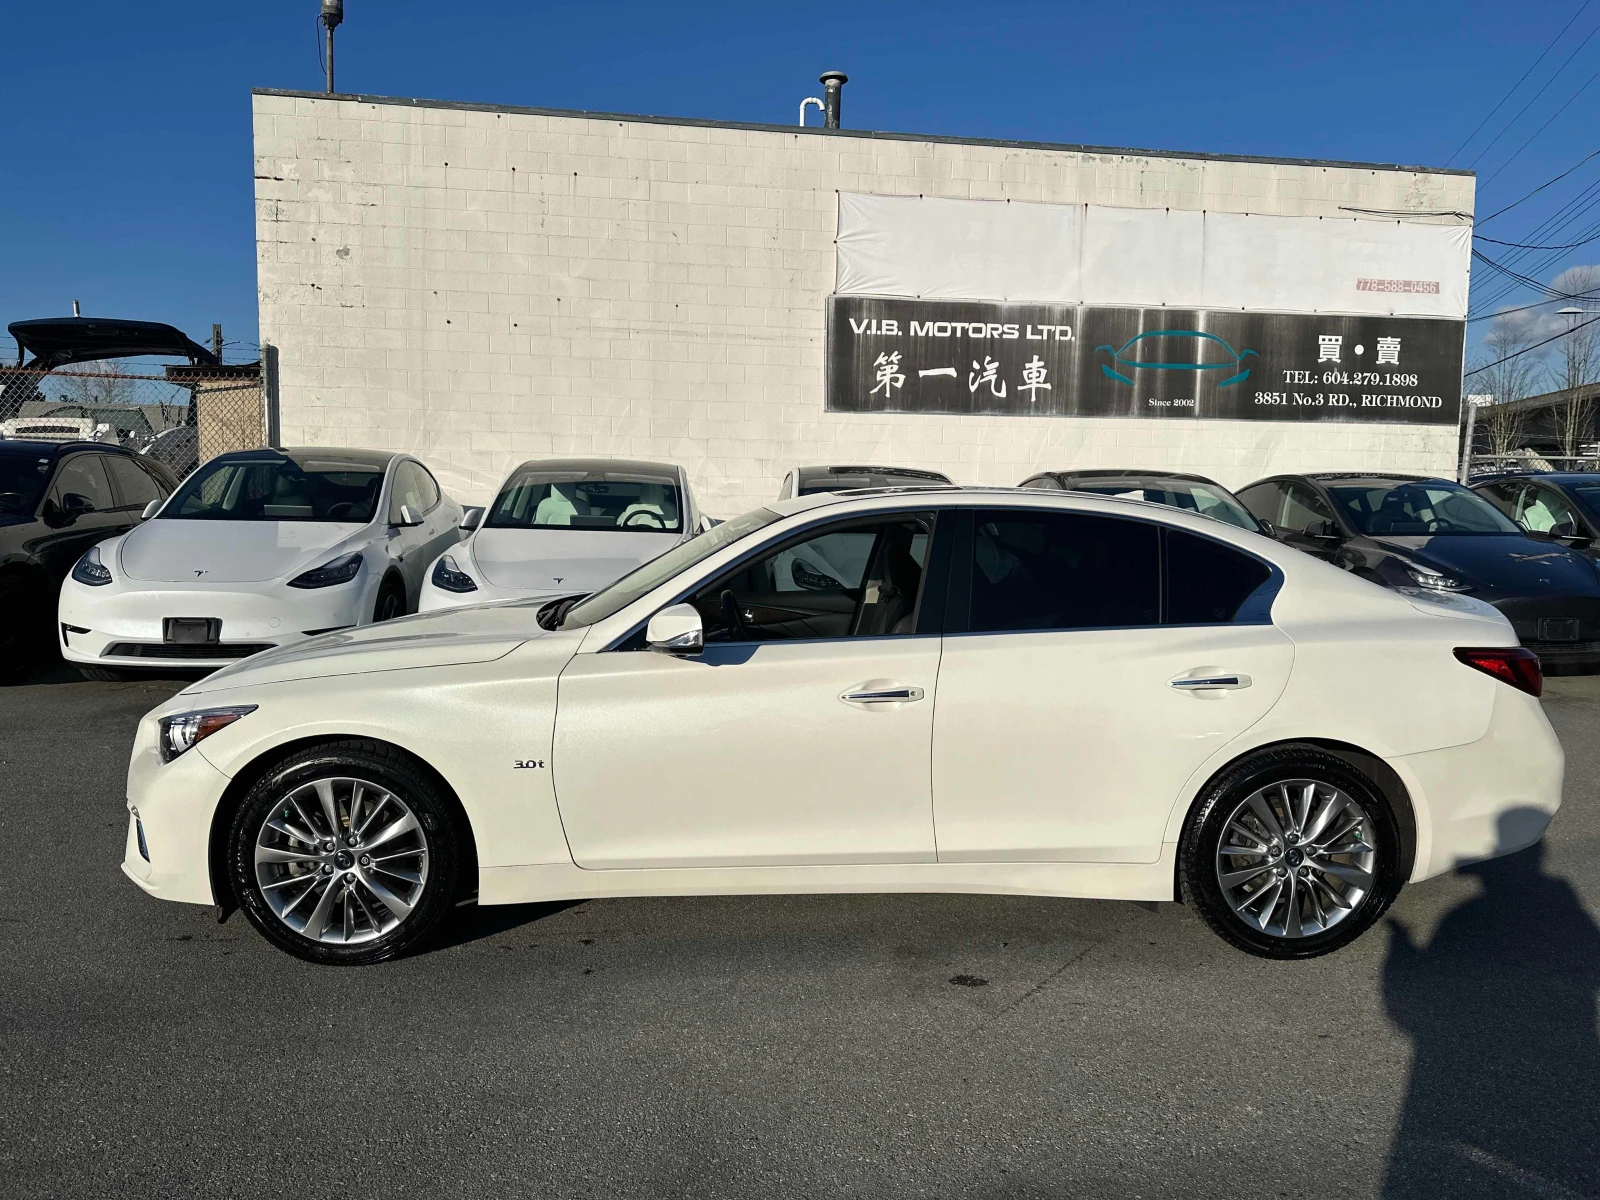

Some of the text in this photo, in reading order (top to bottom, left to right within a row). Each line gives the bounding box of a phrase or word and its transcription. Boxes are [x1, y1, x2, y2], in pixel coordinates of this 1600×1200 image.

[1357, 278, 1437, 294] 778-588-0456
[848, 318, 1076, 341] V.I.B. MOTORS LTD.
[869, 350, 1053, 402] 第一汽車
[1282, 369, 1419, 387] TEL: 604.279.1898
[1148, 397, 1195, 407] Since 2002
[1254, 391, 1443, 409] 3851 No.3 RD., RICHMOND
